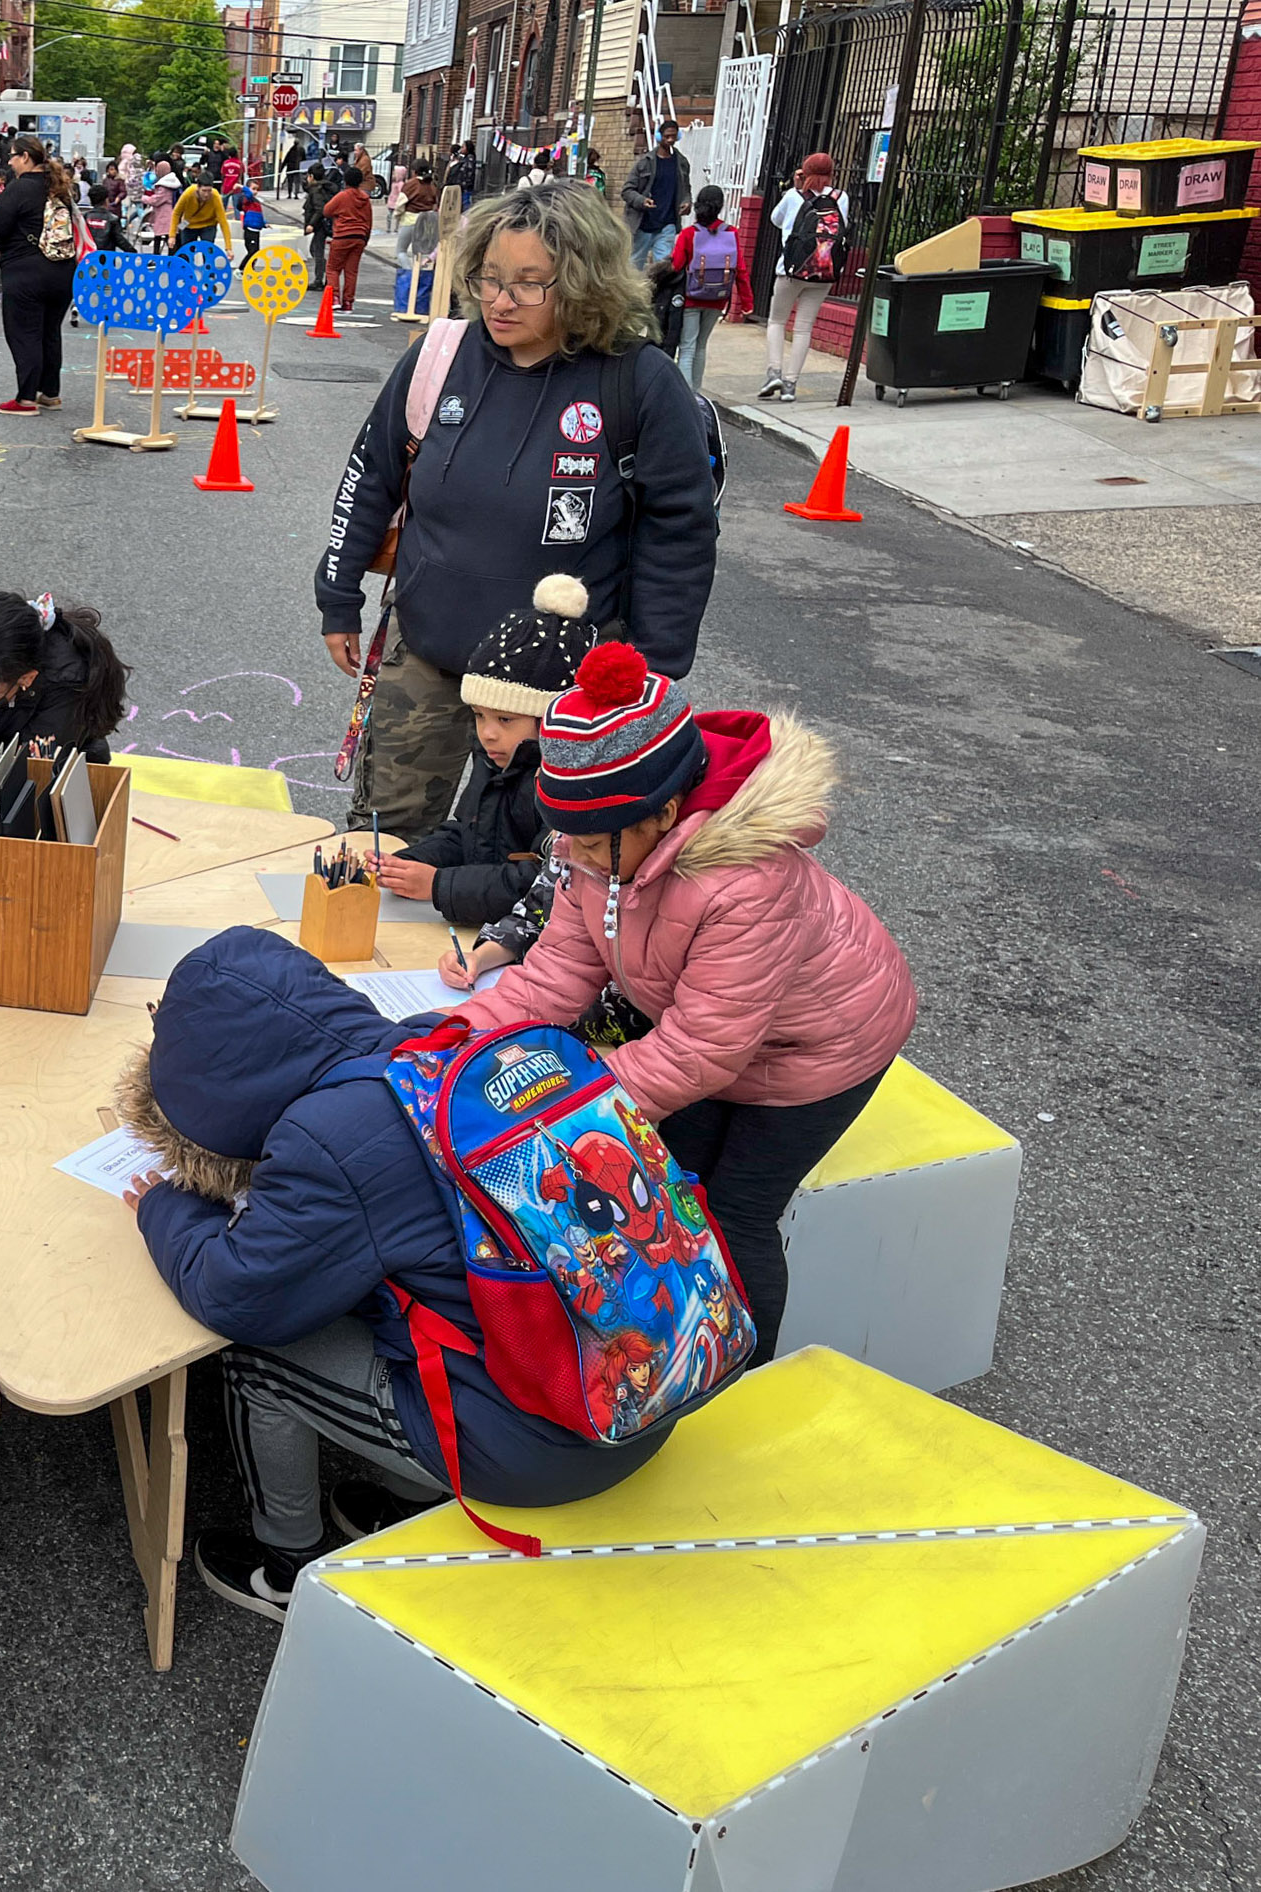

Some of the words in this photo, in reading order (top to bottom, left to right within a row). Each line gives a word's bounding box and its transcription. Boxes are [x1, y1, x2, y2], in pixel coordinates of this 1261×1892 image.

[273, 93, 297, 105] STOP
[1087, 173, 1107, 187] DRAW
[1119, 179, 1138, 190] DRAW
[1185, 170, 1223, 187] DRAW
[1153, 241, 1176, 249] STREET
[1148, 249, 1173, 257] MARKER
[336, 465, 363, 514] PRAY
[329, 513, 350, 550] FOR
[488, 1063, 537, 1107] SUPER
[526, 1053, 566, 1078] HERO
[513, 1075, 567, 1109] ADVENTURES
